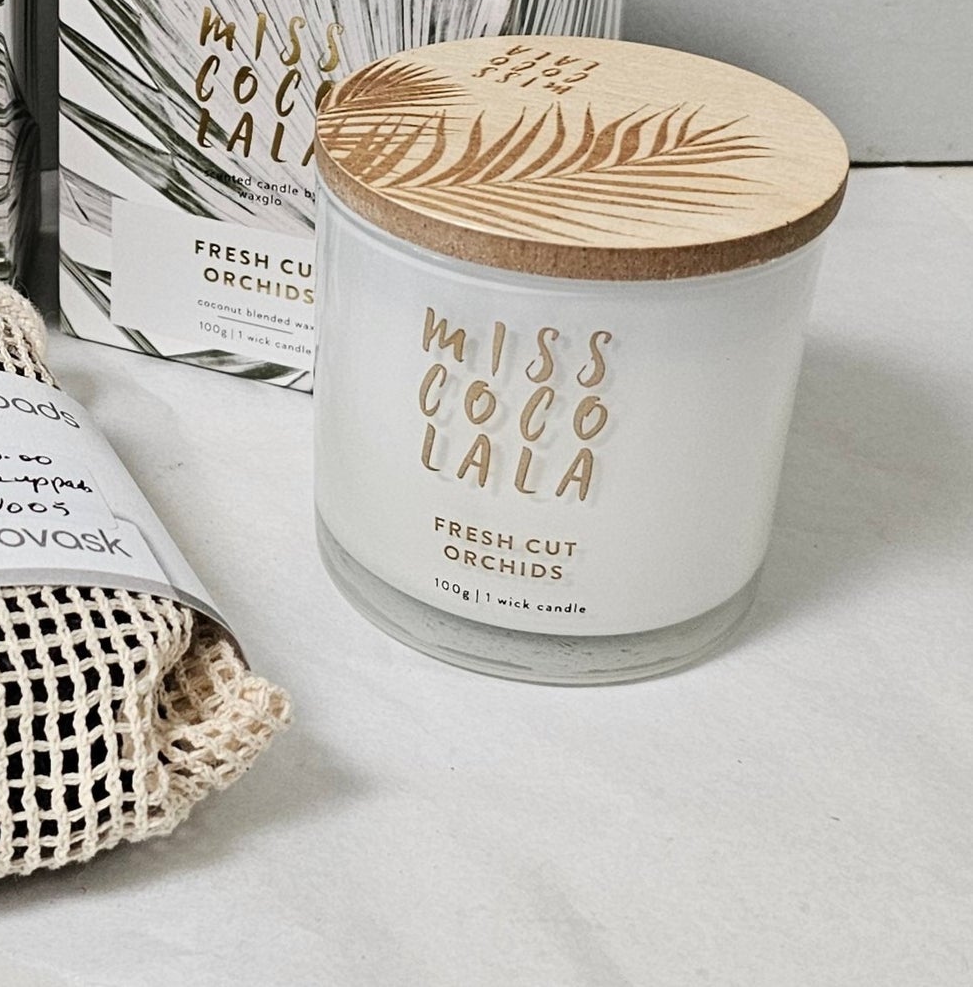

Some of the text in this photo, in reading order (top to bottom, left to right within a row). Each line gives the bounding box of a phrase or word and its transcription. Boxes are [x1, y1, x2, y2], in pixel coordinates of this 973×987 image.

[199, 6, 344, 73] MISS
[489, 56, 589, 83] COCO
[506, 45, 600, 72] LALA
[197, 107, 315, 167] LAL
[238, 190, 282, 206] waxglo
[257, 180, 299, 196] candle
[194, 239, 313, 278] FRESH CU
[203, 267, 315, 305] ORCHIDS
[197, 299, 315, 331] coconut blended wax
[247, 335, 270, 346] wick
[274, 341, 313, 355] candle
[422, 306, 612, 389] MISS
[418, 363, 608, 442] COCO
[421, 422, 595, 502] LALA
[434, 516, 577, 557] FRESH CUT
[444, 545, 563, 580] ORCHIDS
[497, 597, 530, 610] wick
[537, 603, 587, 614] candle
